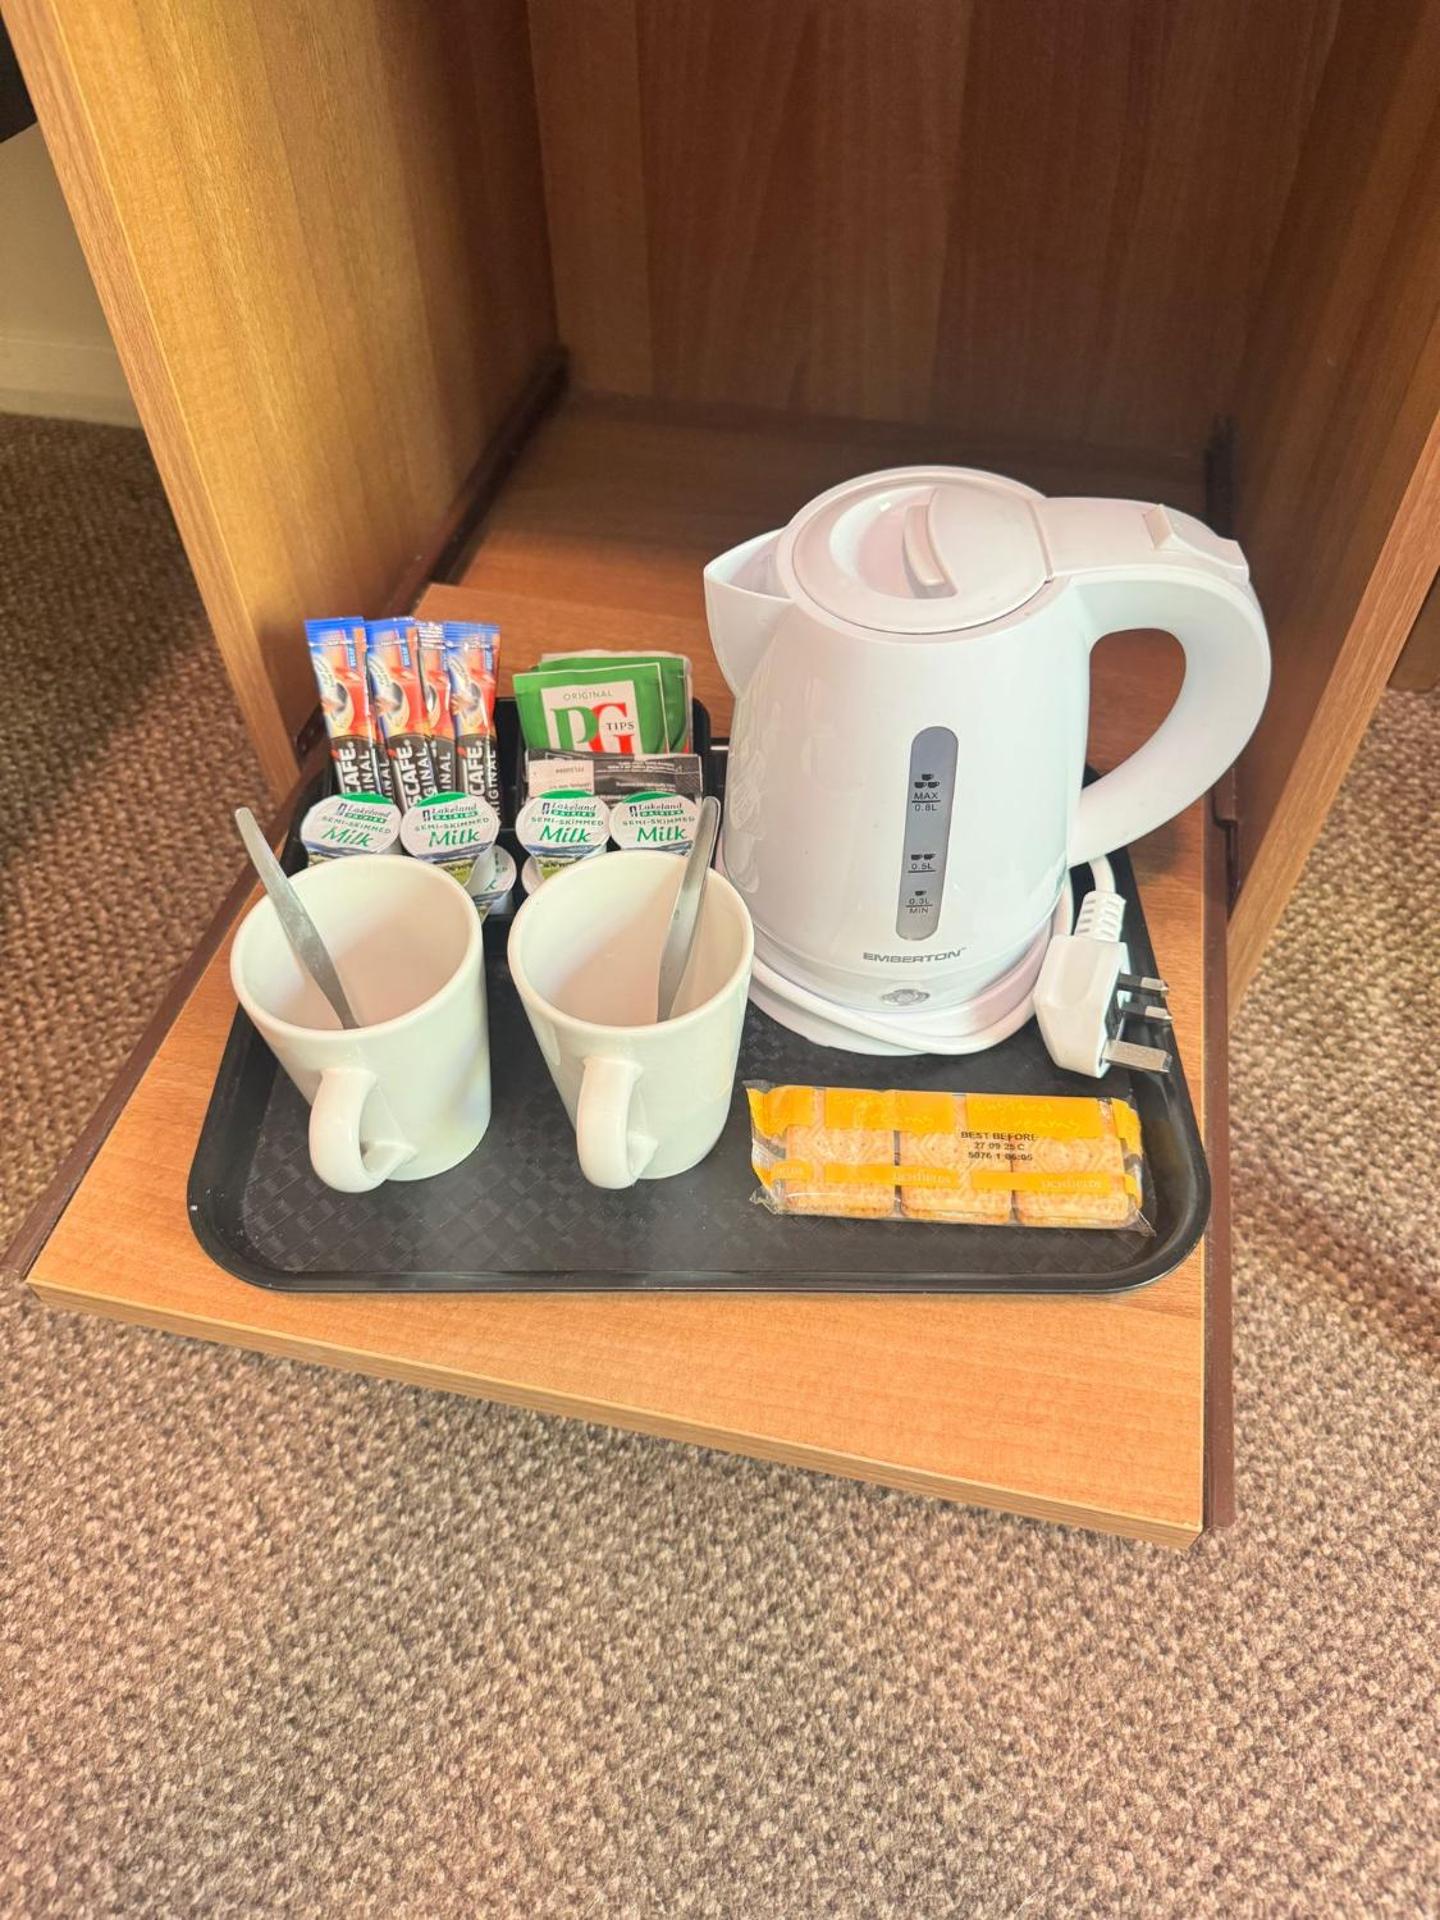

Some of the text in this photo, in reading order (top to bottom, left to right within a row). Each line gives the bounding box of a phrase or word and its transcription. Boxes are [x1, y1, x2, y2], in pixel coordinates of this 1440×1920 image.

[562, 690, 613, 700] ORIGINAL
[550, 702, 635, 756] PG
[606, 722, 634, 731] TIPS
[358, 750, 375, 790] INAL
[415, 748, 437, 797] GINAL
[439, 752, 452, 790] INAL
[914, 792, 938, 800] MAX
[915, 803, 937, 811] 0.8L
[322, 816, 391, 834] SEMI-SKIMMED
[414, 817, 489, 831] SEMI-SKIMMED
[531, 816, 604, 826] SEMI-SKIMMED
[623, 816, 695, 826] SEMI-SKIMMED
[321, 827, 374, 847] Milk
[429, 829, 480, 848] Milk
[539, 825, 592, 843] Milk
[636, 825, 688, 842] Milk
[908, 906, 929, 914] MIN
[863, 949, 961, 963] EMBERTON
[960, 1131, 1038, 1141] BEST BEFORE
